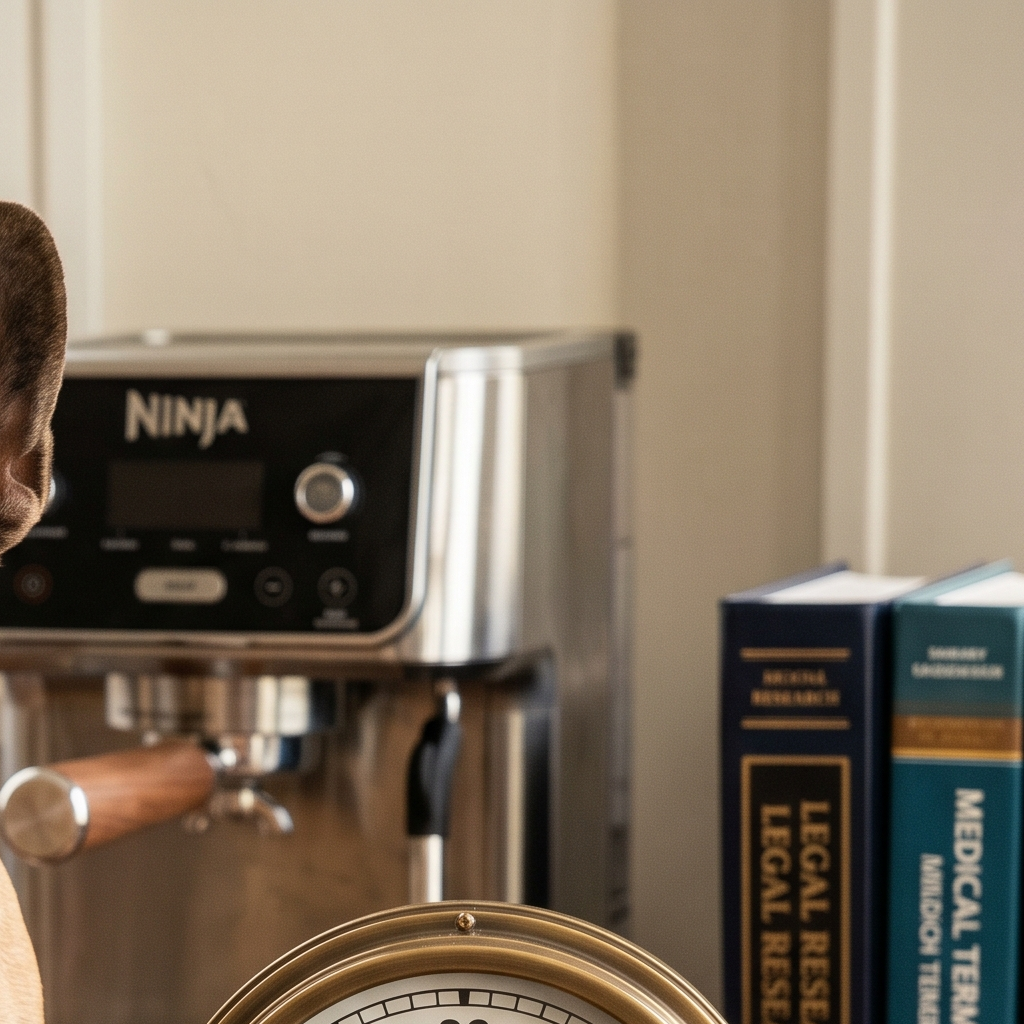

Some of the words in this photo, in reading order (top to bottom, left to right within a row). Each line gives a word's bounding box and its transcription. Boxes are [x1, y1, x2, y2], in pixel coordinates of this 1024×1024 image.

[760, 804, 792, 923] LEGAL
[798, 800, 831, 922] LEGAL
[950, 787, 986, 938] MEDICAL
